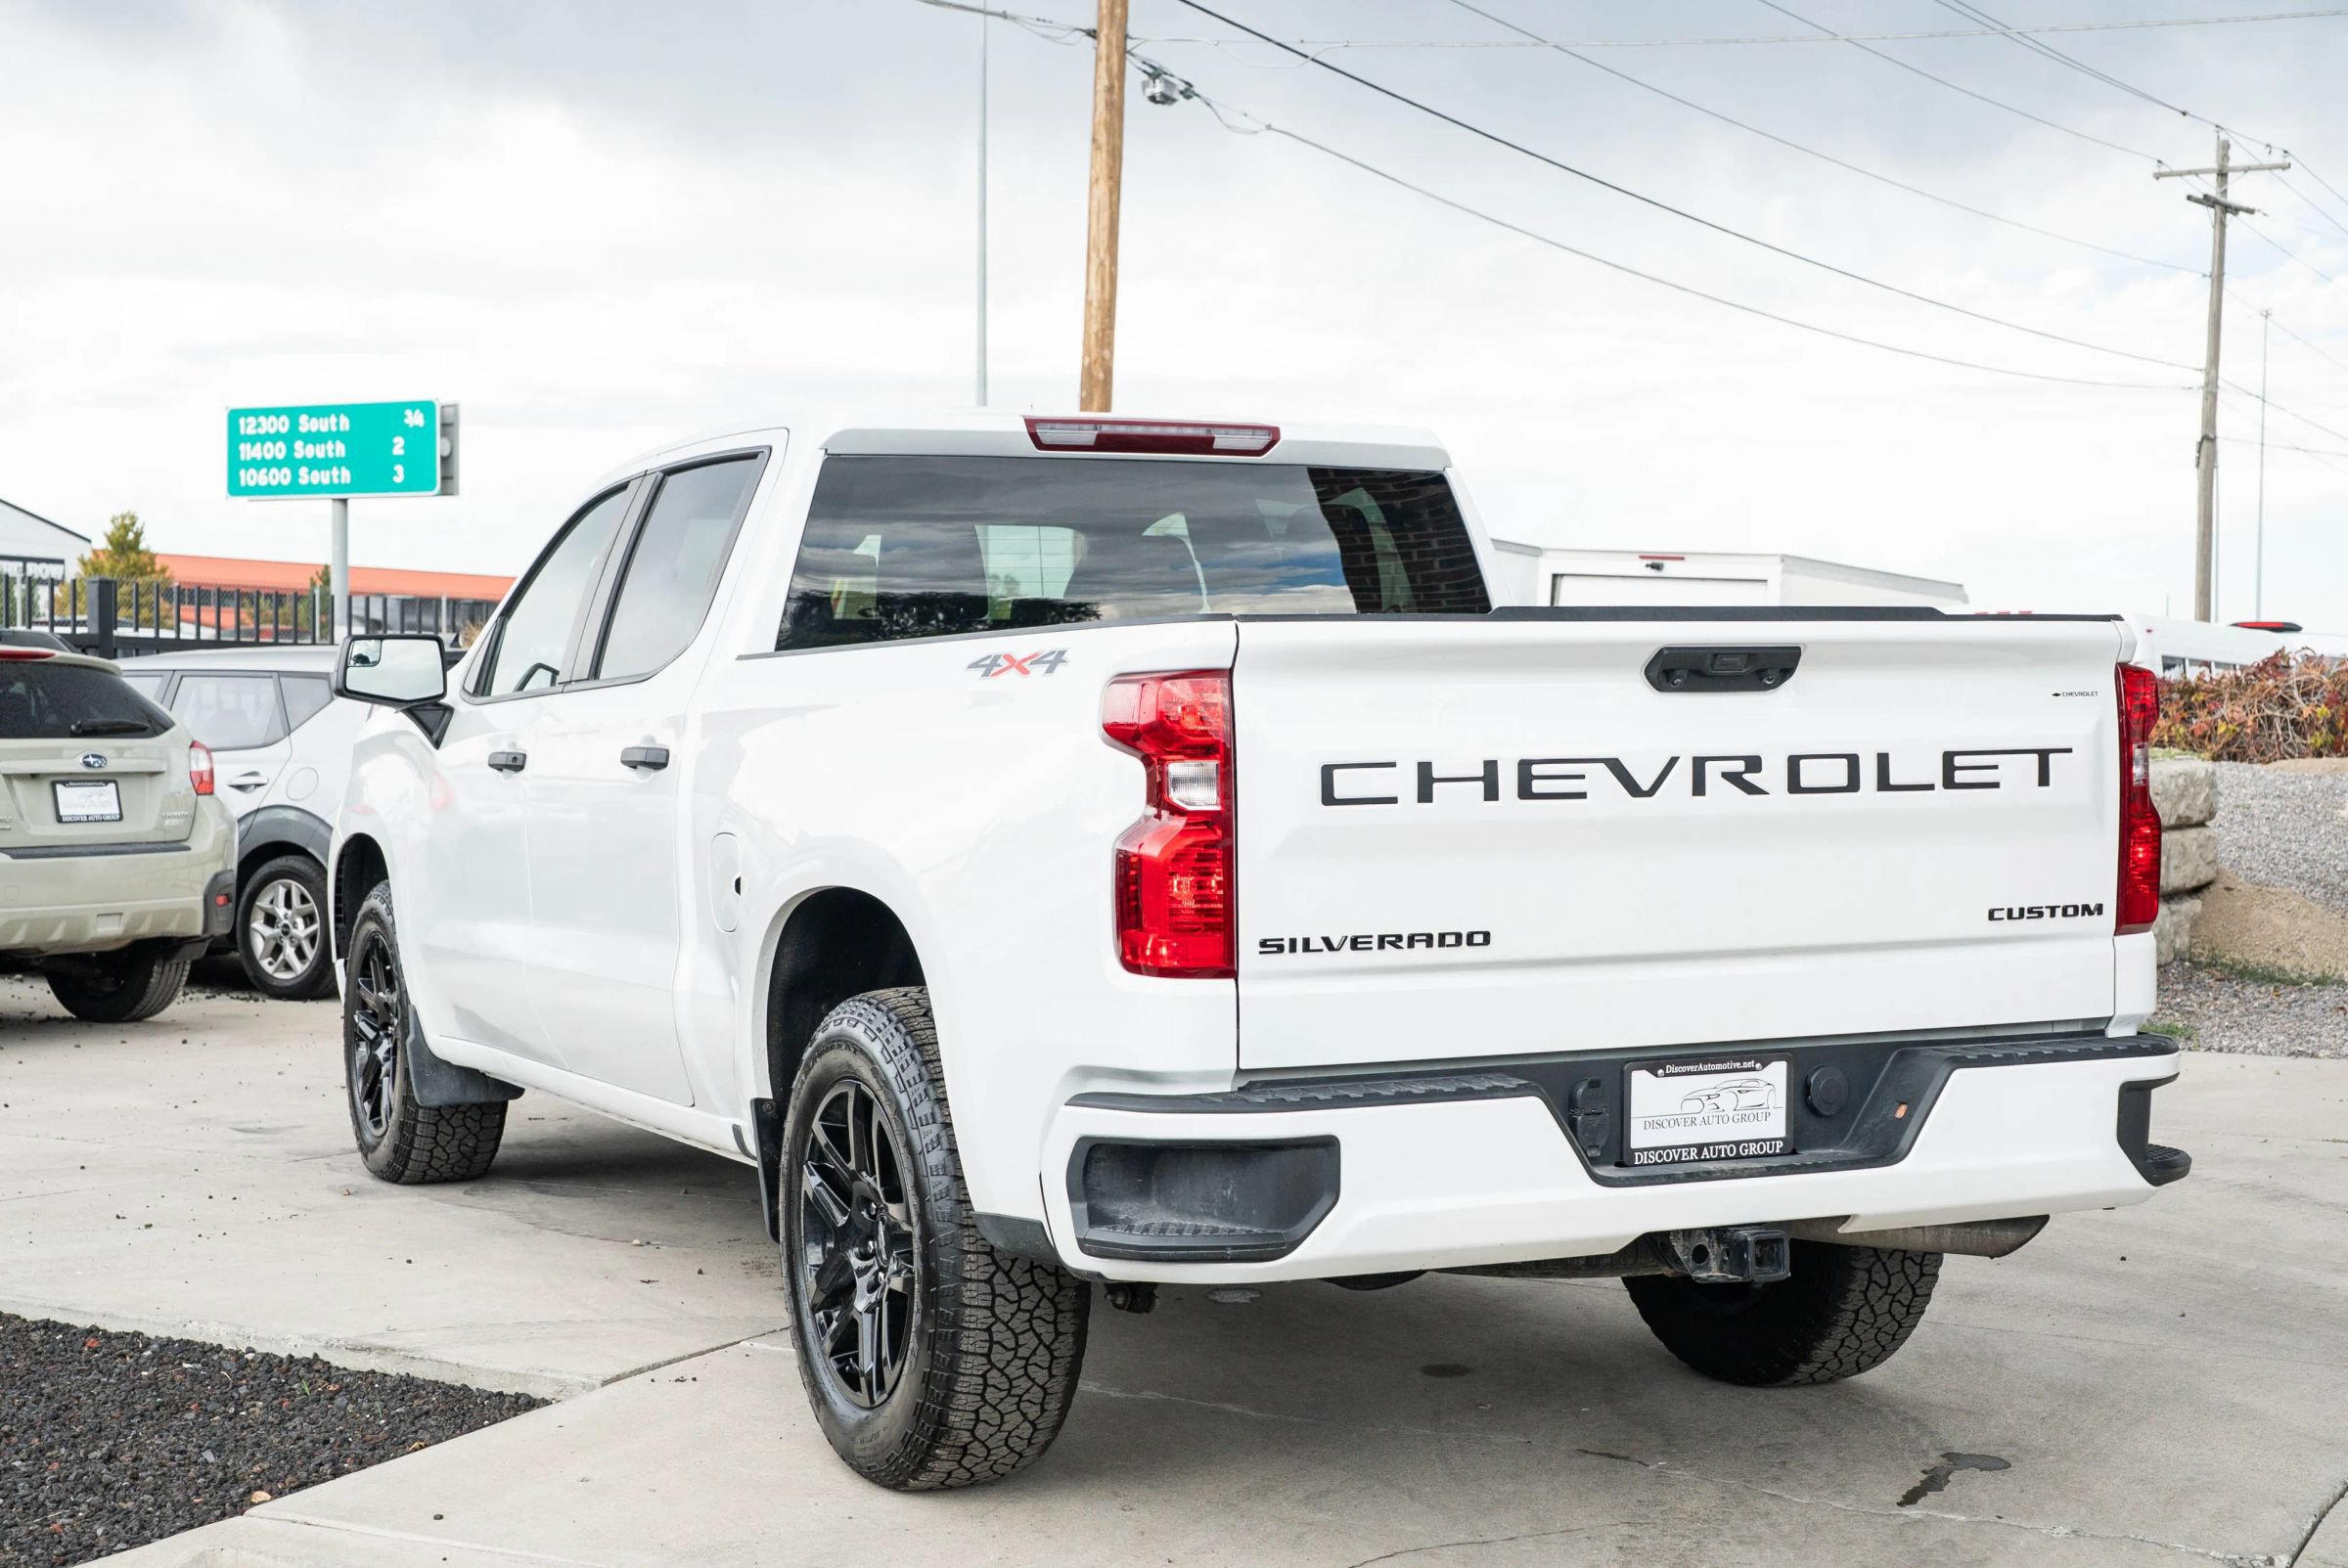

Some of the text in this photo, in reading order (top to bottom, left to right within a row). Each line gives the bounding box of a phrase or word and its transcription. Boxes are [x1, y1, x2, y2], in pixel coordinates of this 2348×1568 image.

[239, 415, 290, 434] 12300
[298, 413, 350, 433] South
[239, 436, 405, 461] 11400 South 2
[239, 464, 405, 487] 10600 South 3
[1320, 746, 2073, 806] CHEVROLET
[1987, 903, 2103, 921] CUSTOM
[1258, 930, 1491, 955] SILVERADO
[1665, 1059, 1755, 1074] DiscoverAutomotive.net
[1644, 1111, 1771, 1131] DISCOVER AUTO GROUP
[1634, 1141, 1784, 1165] DISCOVER AUTO GROUP
